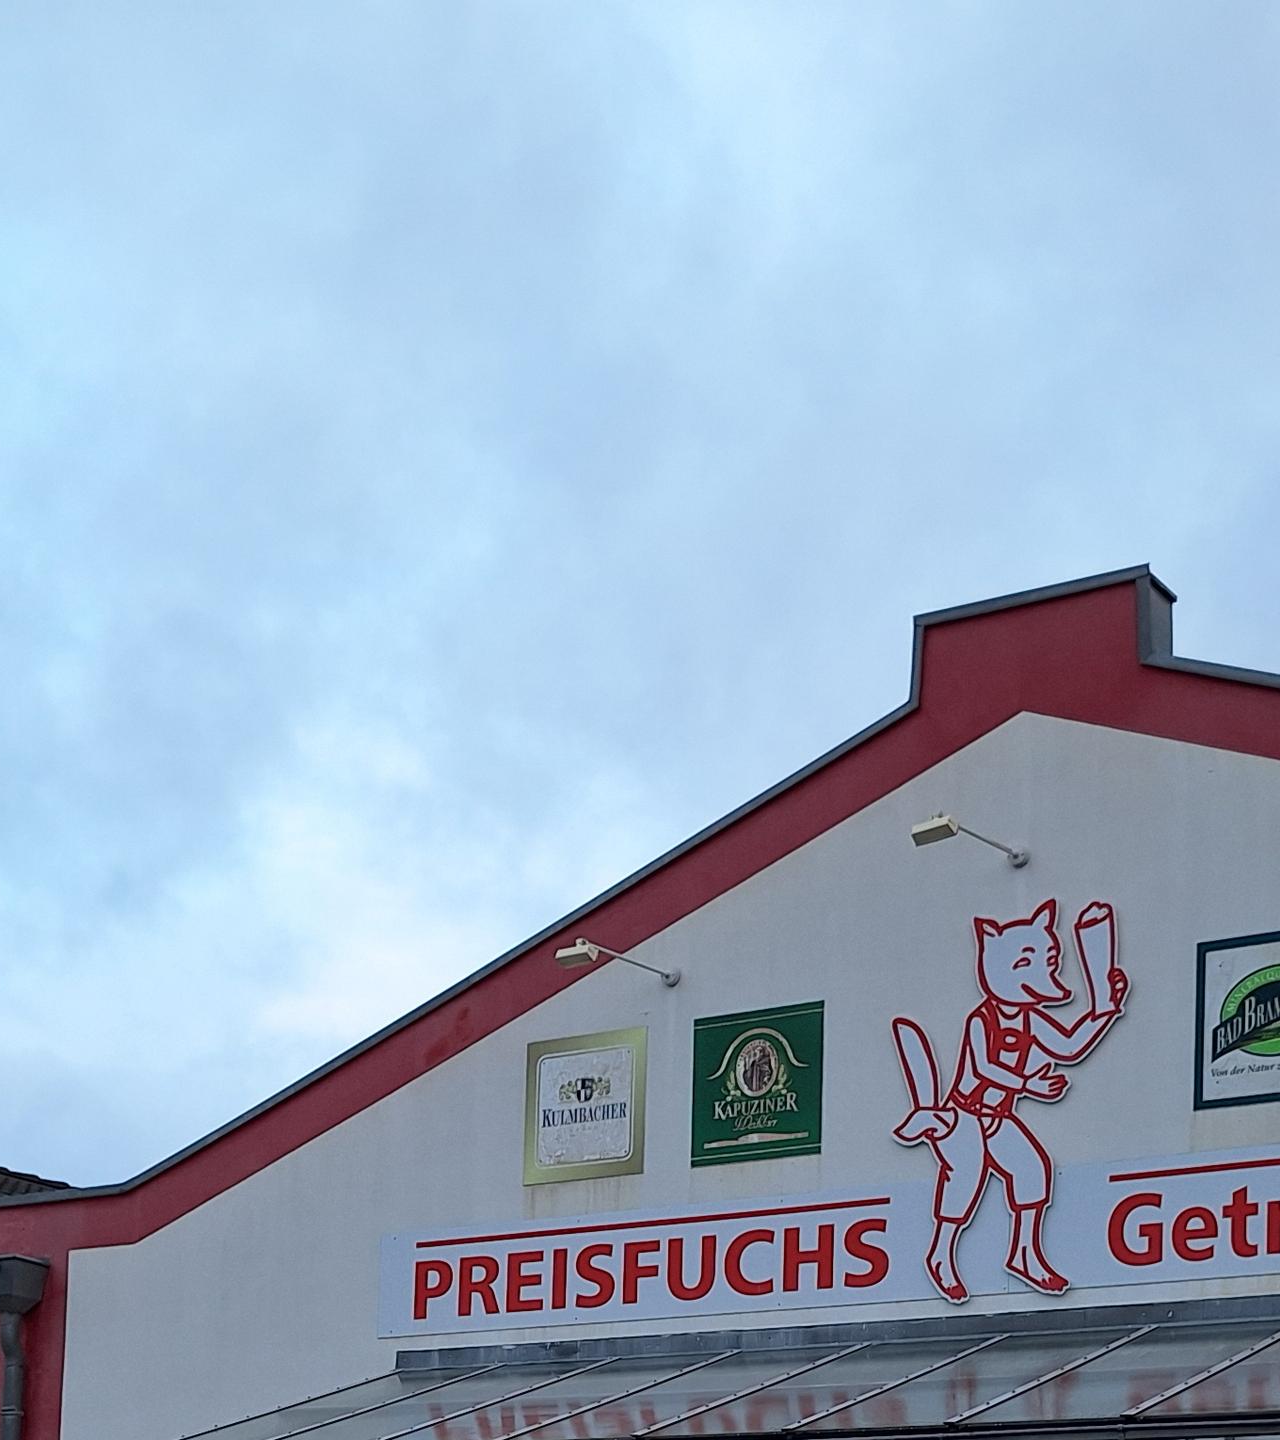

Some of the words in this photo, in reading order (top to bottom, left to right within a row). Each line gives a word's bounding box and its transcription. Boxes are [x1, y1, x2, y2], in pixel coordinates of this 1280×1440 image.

[1216, 1016, 1242, 1054] BAD
[1211, 1068, 1228, 1077] Von
[1230, 1065, 1245, 1076] der
[1248, 1063, 1275, 1074] Natur
[541, 1102, 627, 1128] KULMBACHER
[713, 1092, 799, 1120] KAPUZINER
[412, 1218, 892, 1319] PREISFUCHS
